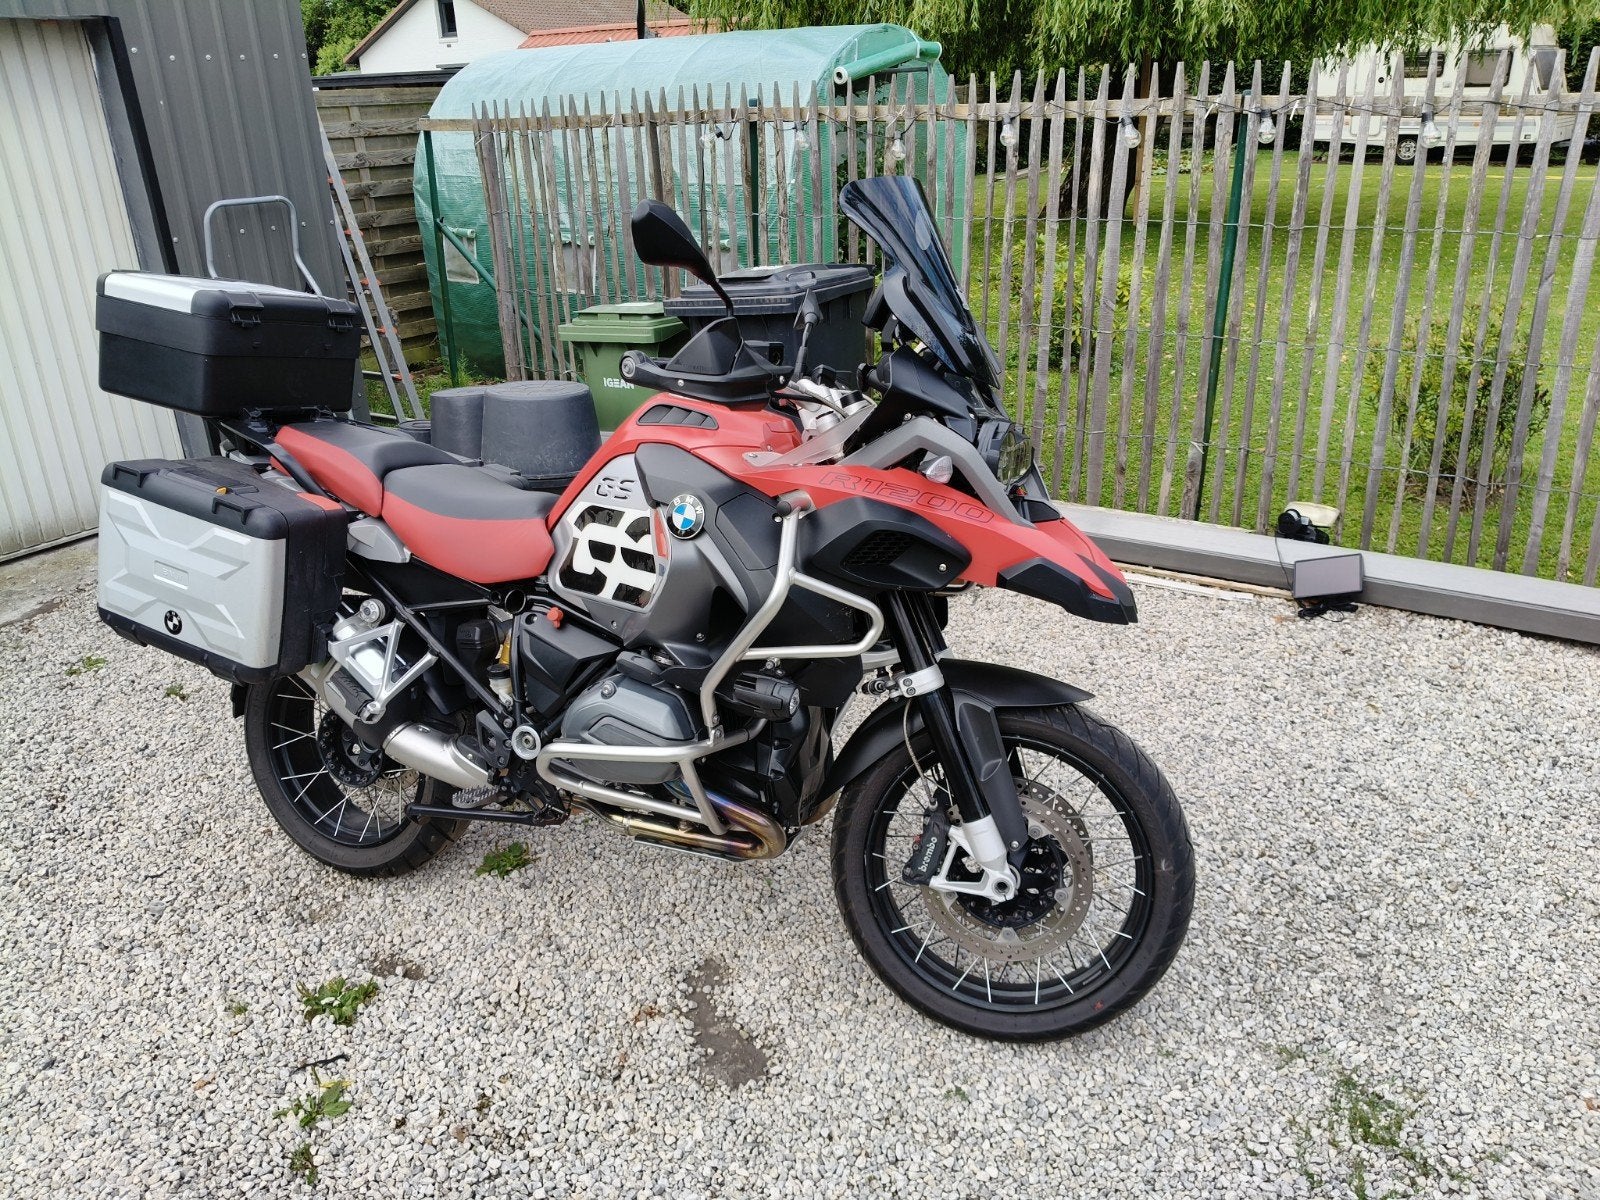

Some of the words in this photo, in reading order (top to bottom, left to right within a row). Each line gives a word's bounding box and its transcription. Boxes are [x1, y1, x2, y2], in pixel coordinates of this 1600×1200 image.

[596, 477, 635, 499] GS
[819, 471, 995, 523] R1200
[918, 836, 938, 873] brembo
